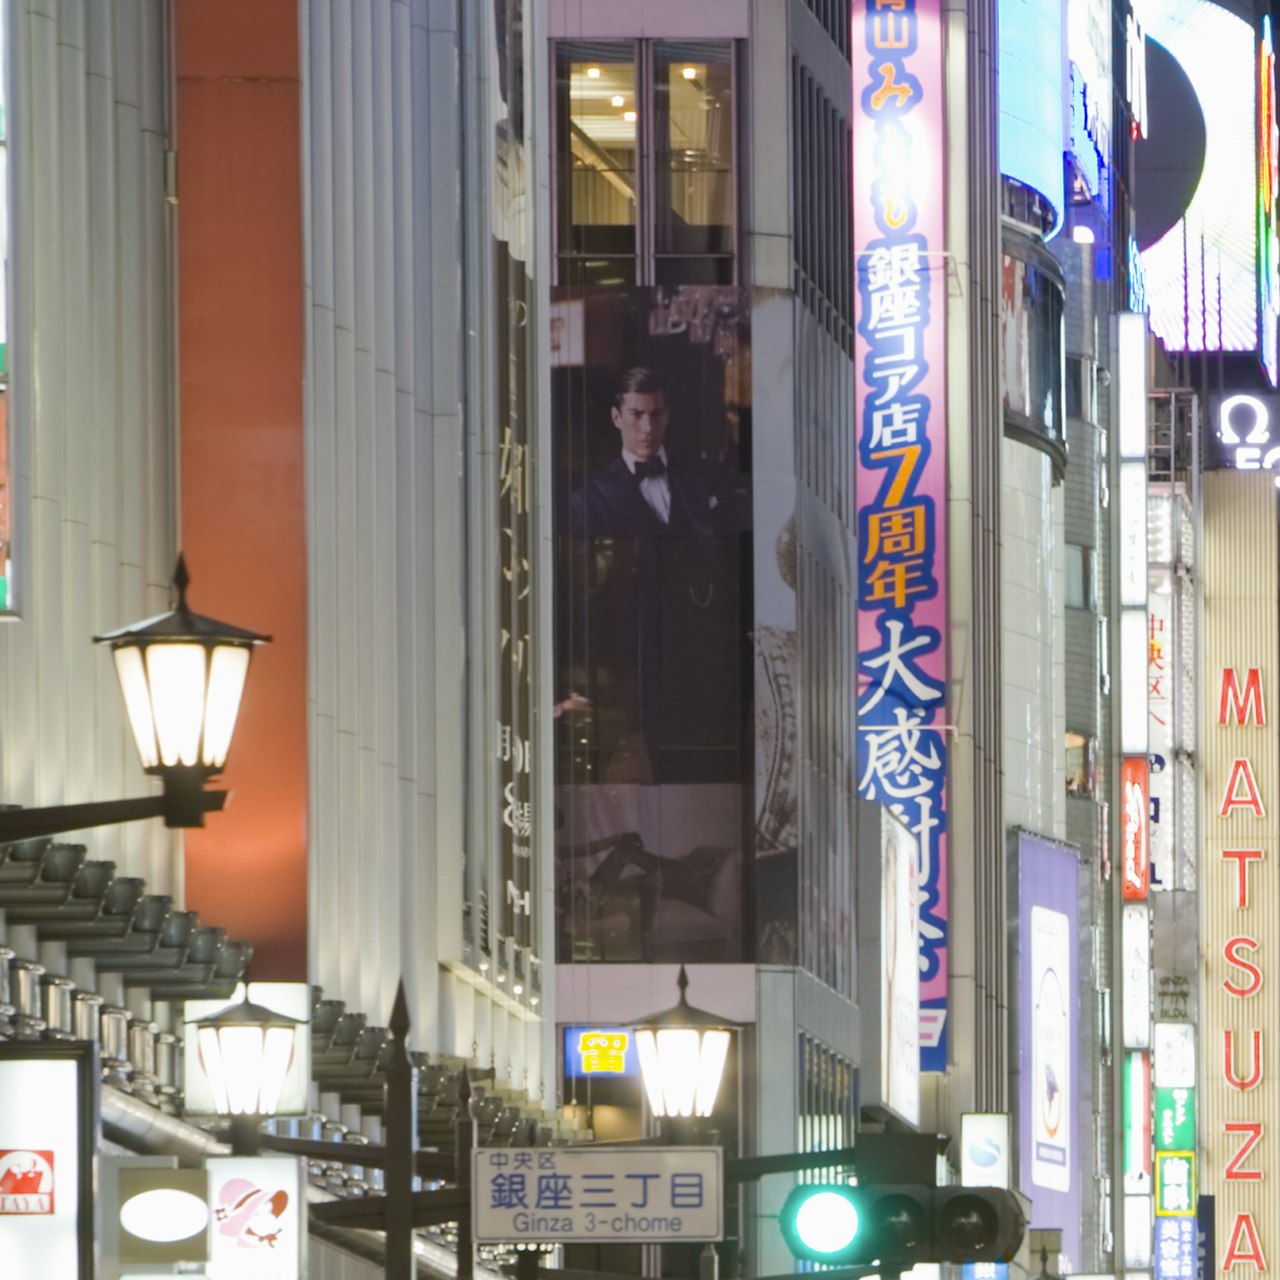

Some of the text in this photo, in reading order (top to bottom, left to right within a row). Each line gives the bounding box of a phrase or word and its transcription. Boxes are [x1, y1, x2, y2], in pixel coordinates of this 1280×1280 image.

[489, 1153, 556, 1171] 中央区
[490, 1173, 704, 1210] 銀座三丁目
[513, 1212, 683, 1233] Ginza 3-chome
